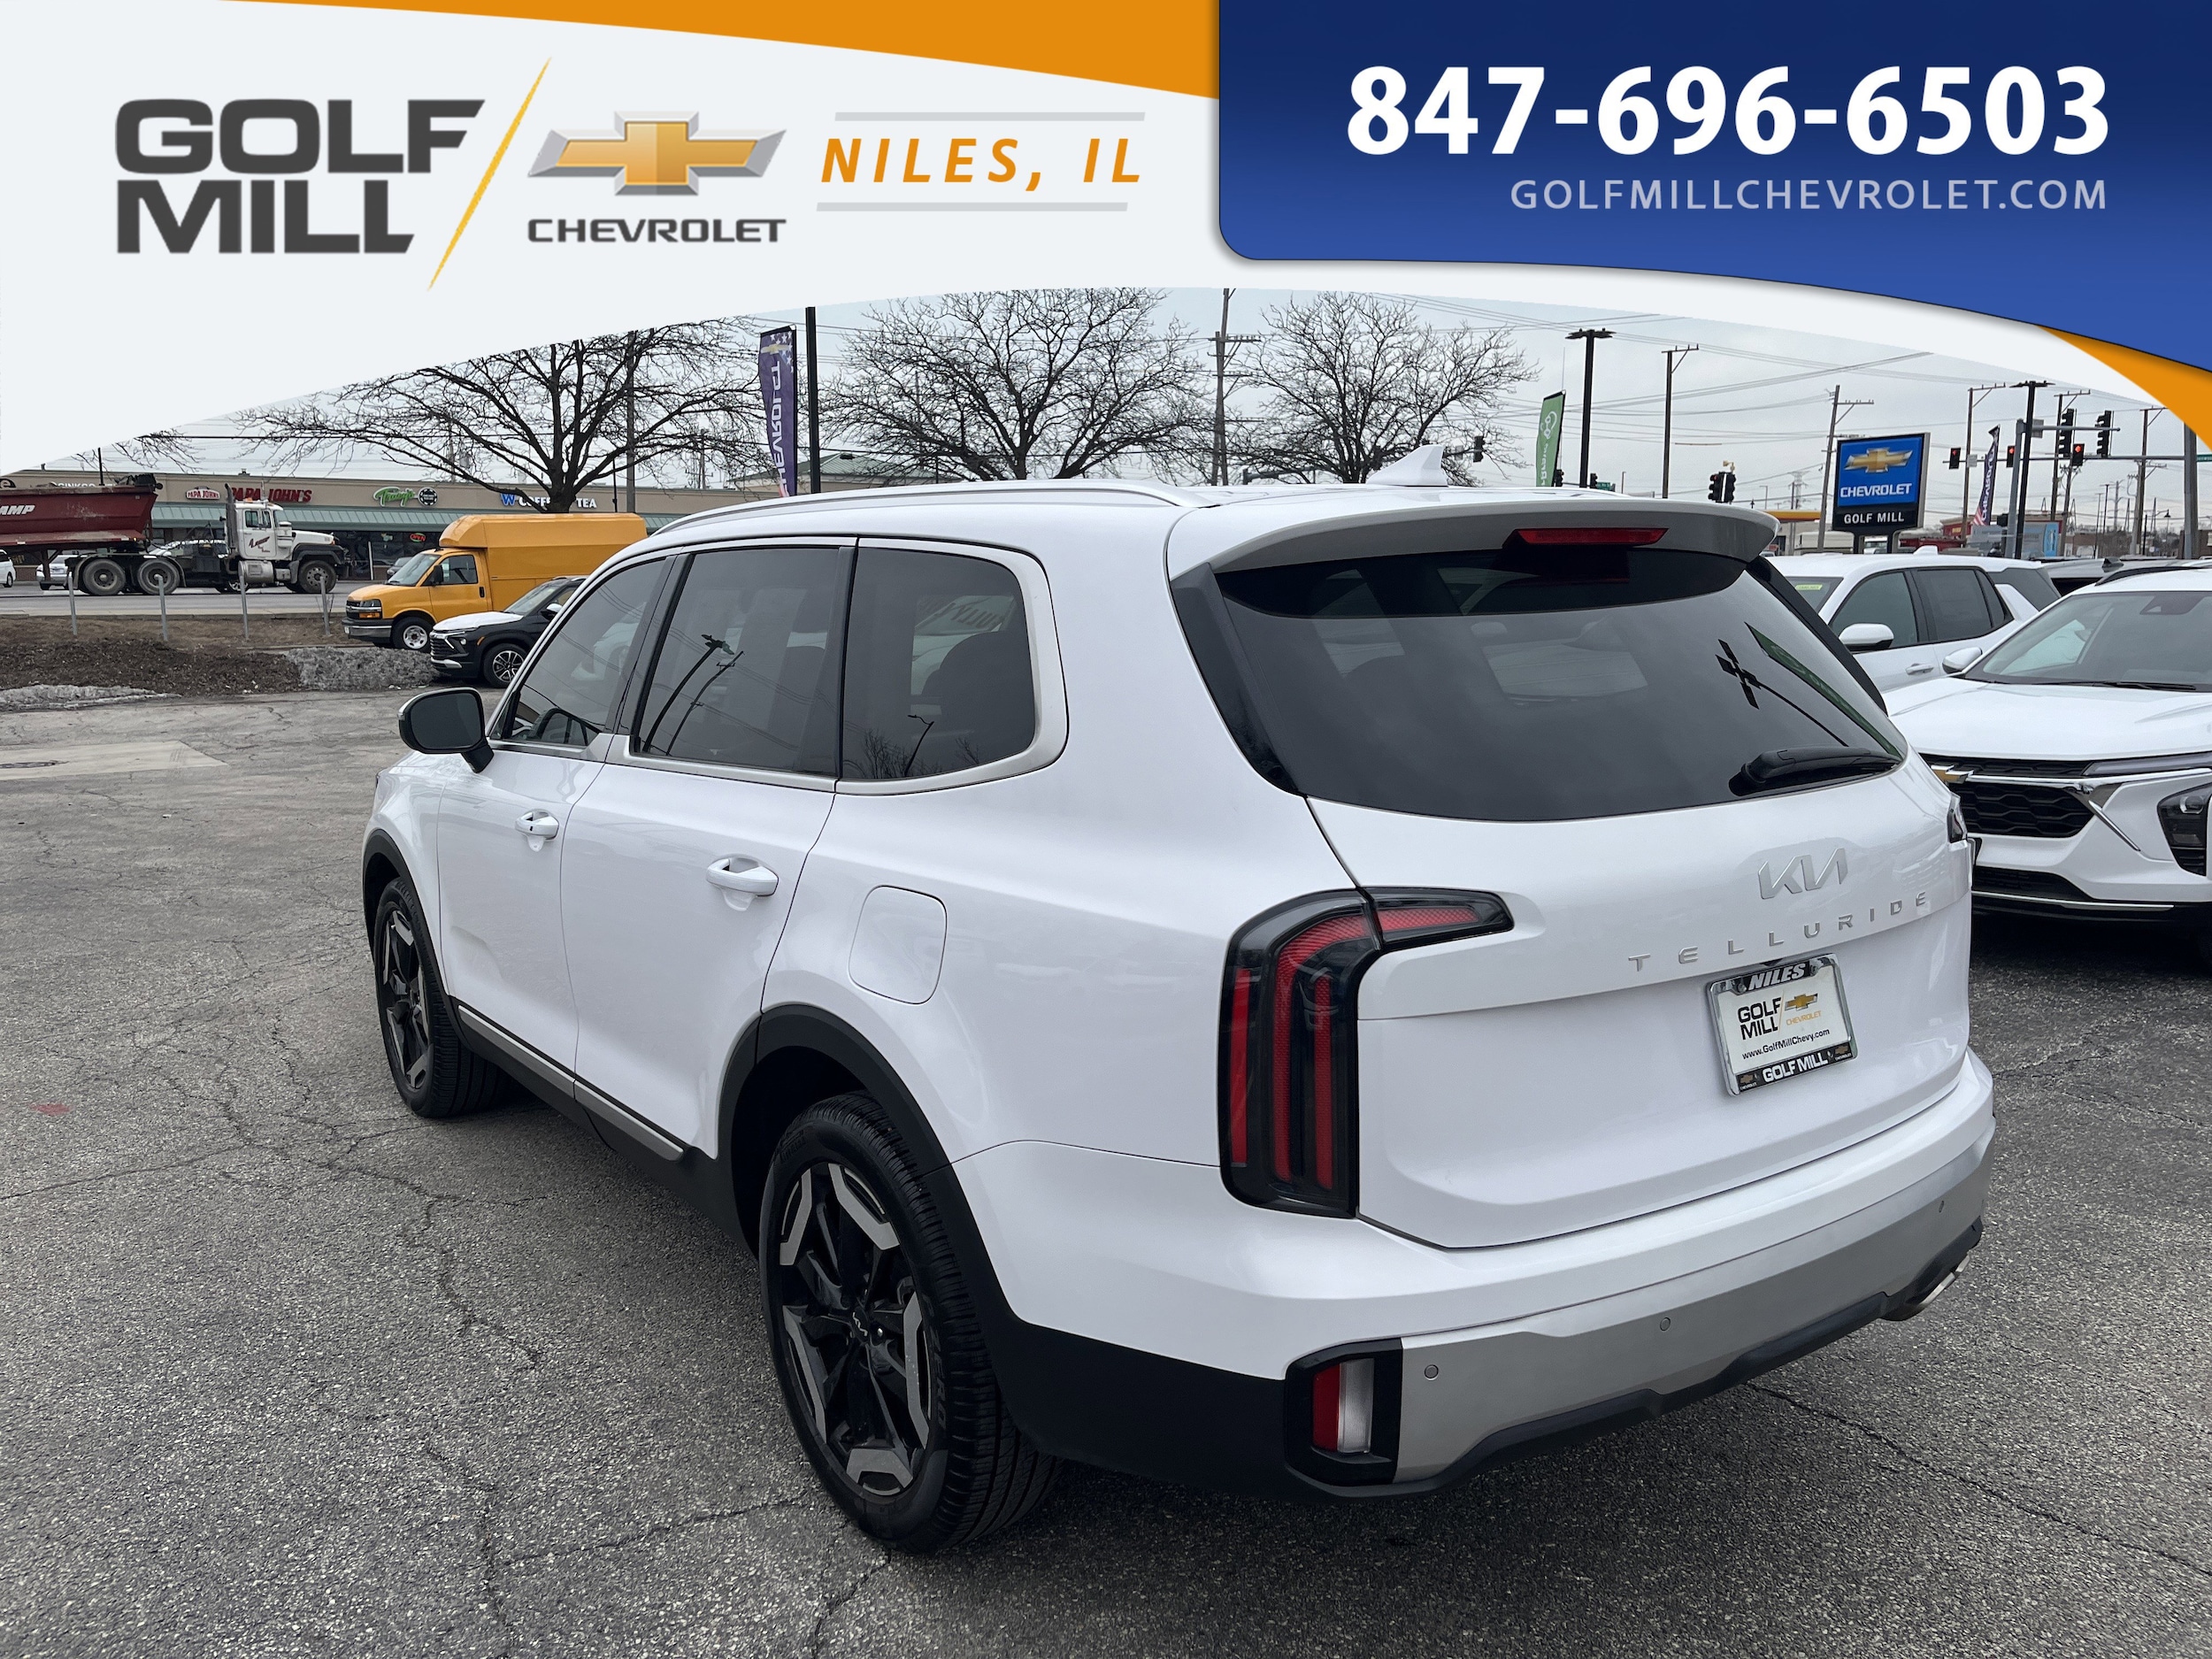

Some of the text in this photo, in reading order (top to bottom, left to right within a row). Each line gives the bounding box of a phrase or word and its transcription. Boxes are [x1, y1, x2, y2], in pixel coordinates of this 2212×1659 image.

[576, 498, 596, 508] TEA
[1840, 483, 1912, 498] CHEVROLET
[1844, 511, 1904, 524] GOLF MILL
[1757, 848, 1848, 900] KIA
[1628, 892, 1926, 972] TELLURIDE
[1748, 964, 1806, 991] NILES
[1738, 997, 1782, 1024] GOLF
[1786, 1010, 1822, 1026] CHEVROLET
[1740, 1017, 1778, 1041] MILL
[1742, 1028, 1831, 1060] www.GolfMillChevy.com
[1763, 1052, 1829, 1083] GOLF MILL
